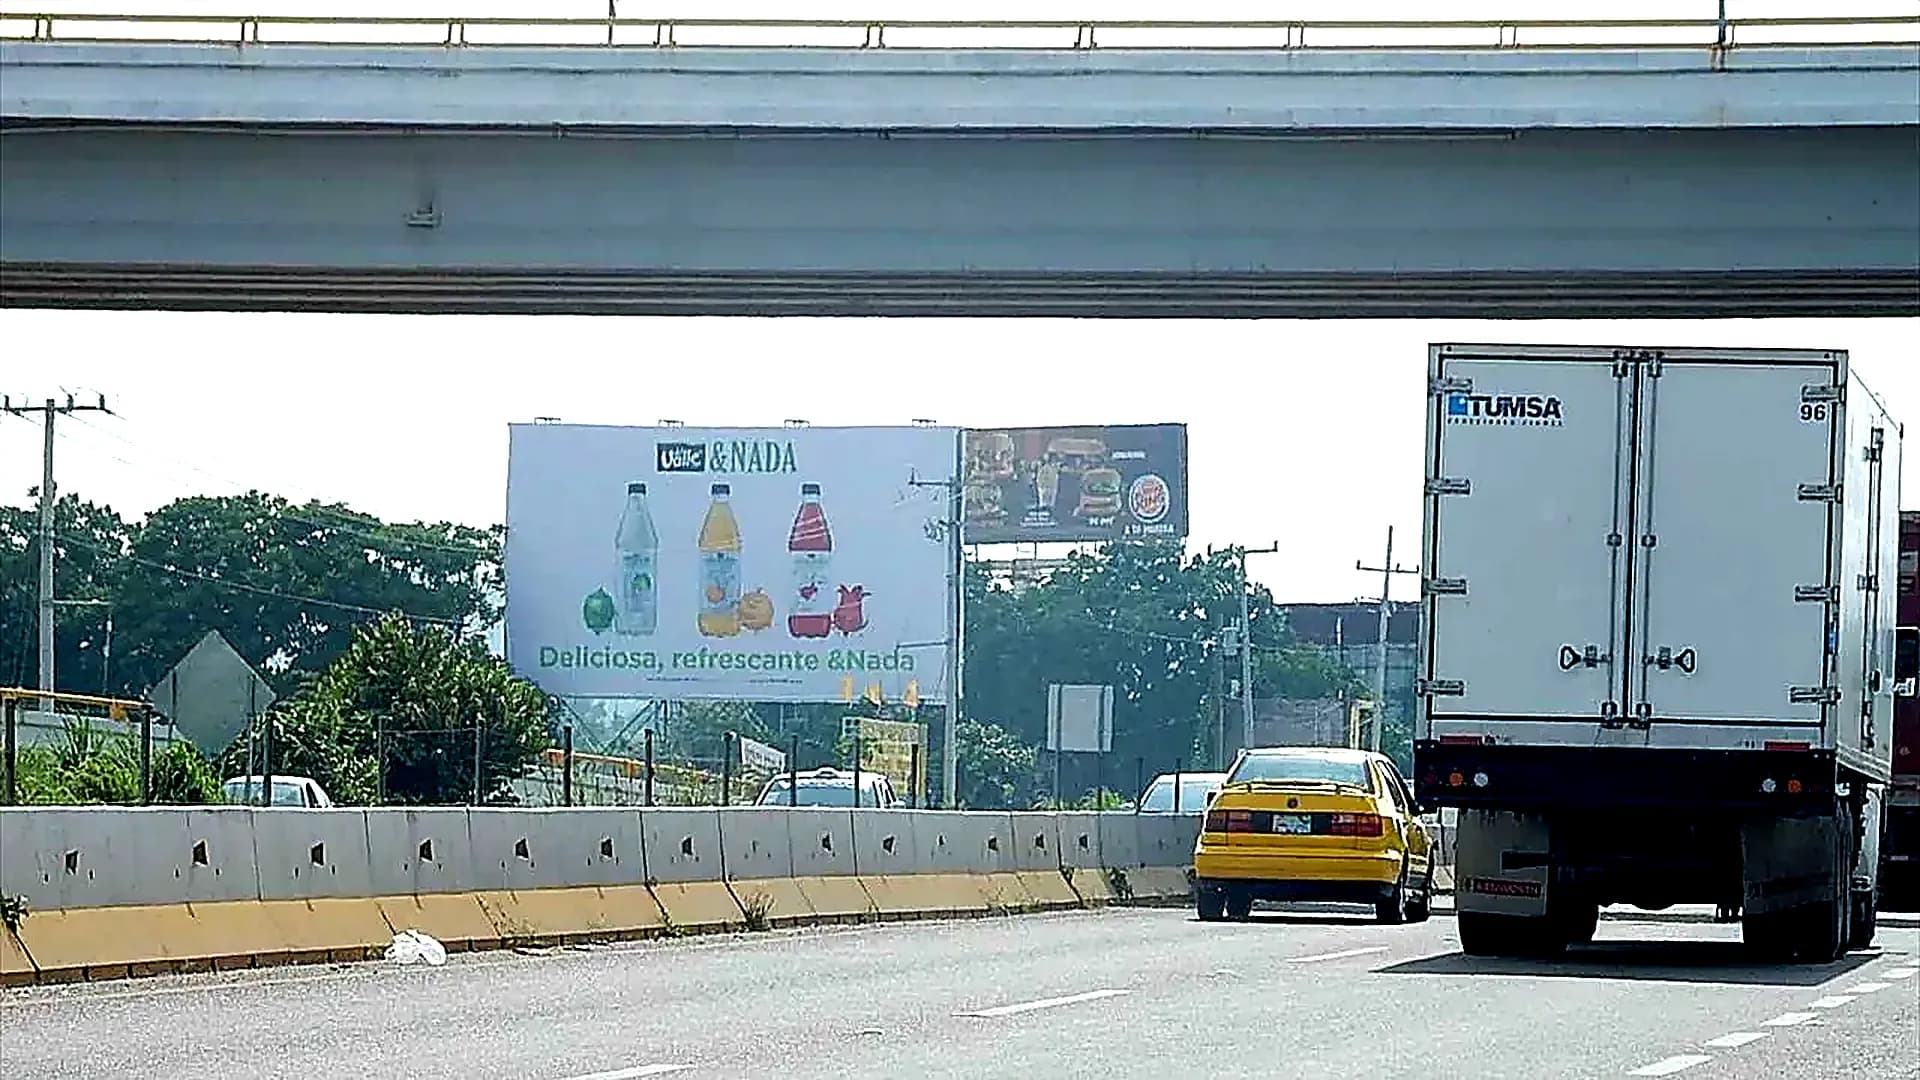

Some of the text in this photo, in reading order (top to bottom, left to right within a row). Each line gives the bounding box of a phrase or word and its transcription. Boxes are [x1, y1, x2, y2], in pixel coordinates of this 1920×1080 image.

[1469, 396, 1561, 419] TUMSA
[1800, 404, 1826, 421] 96
[539, 644, 915, 674] Deliciosa, refrescante &Nada
